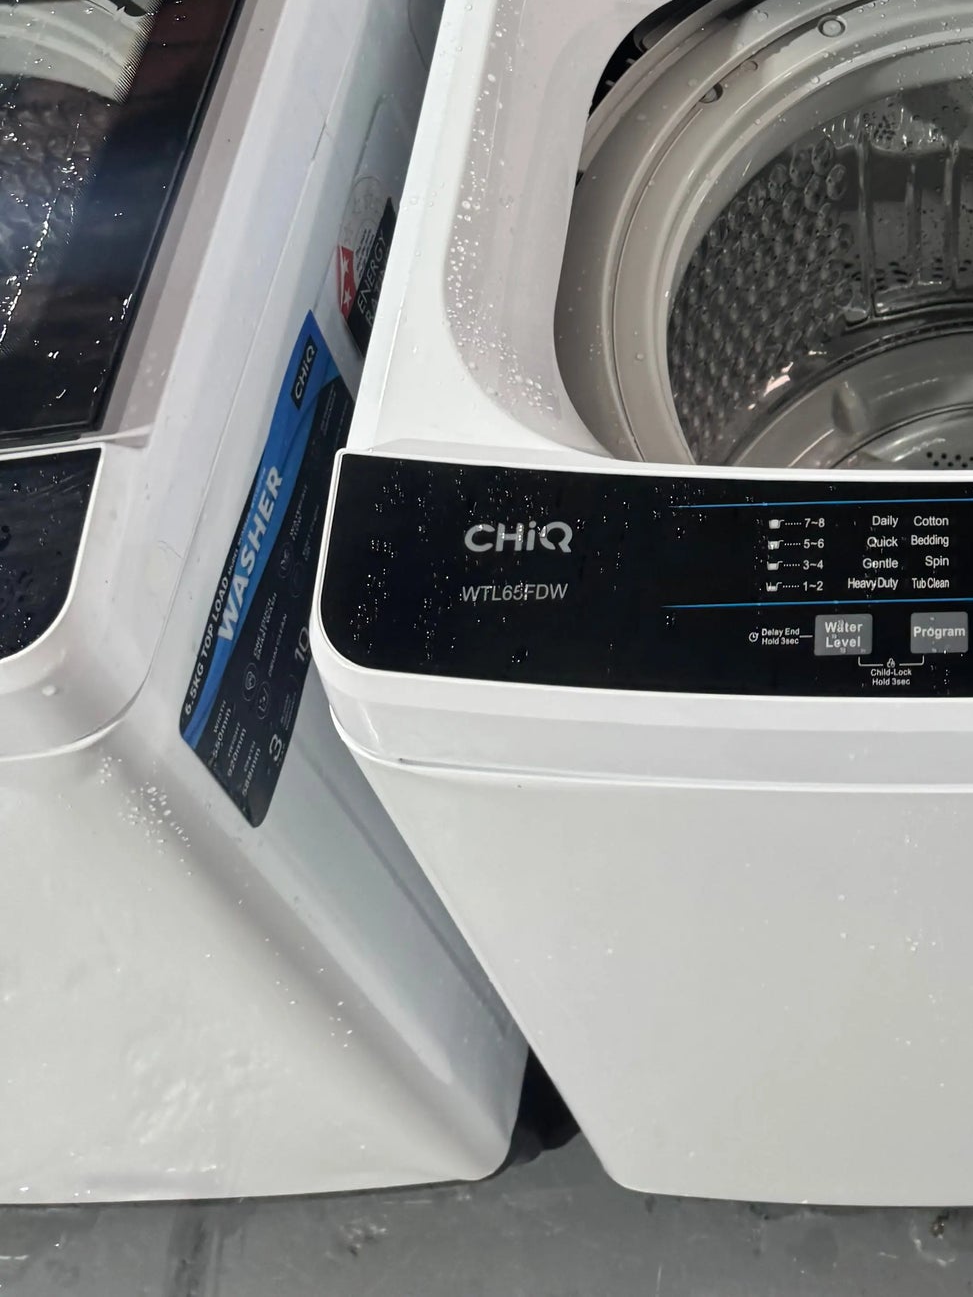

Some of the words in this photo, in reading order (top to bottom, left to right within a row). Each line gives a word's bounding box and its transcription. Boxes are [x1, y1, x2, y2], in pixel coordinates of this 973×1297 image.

[804, 518, 825, 528] 7~8
[872, 515, 899, 527] Daily
[913, 516, 949, 526] Cotton
[464, 521, 573, 552] CHiQ
[867, 536, 898, 548] Quick
[911, 535, 949, 547] Bedding
[803, 538, 825, 548] 5~6
[218, 465, 283, 641] WASHER
[803, 560, 823, 570] 3~4
[862, 558, 899, 569] Gentle
[925, 556, 949, 568] Spin
[803, 581, 823, 591] 1~2
[847, 578, 876, 591] Heavy
[877, 577, 899, 589] Duty
[912, 578, 926, 588] Tub
[927, 578, 950, 588] Clean
[461, 583, 569, 602] WTL65FDW
[761, 628, 783, 638] Delay
[785, 628, 800, 637] End
[825, 622, 863, 633] Water
[913, 626, 965, 638] Program
[184, 664, 205, 716] 6.5KG
[200, 628, 214, 662] TOP
[212, 577, 229, 622] LOAD
[761, 637, 779, 645] Hold
[780, 637, 799, 645] 3sec
[826, 636, 861, 648] Level
[870, 668, 912, 677] Child-Lock
[872, 678, 890, 686] Hold
[892, 677, 911, 685] 3sec
